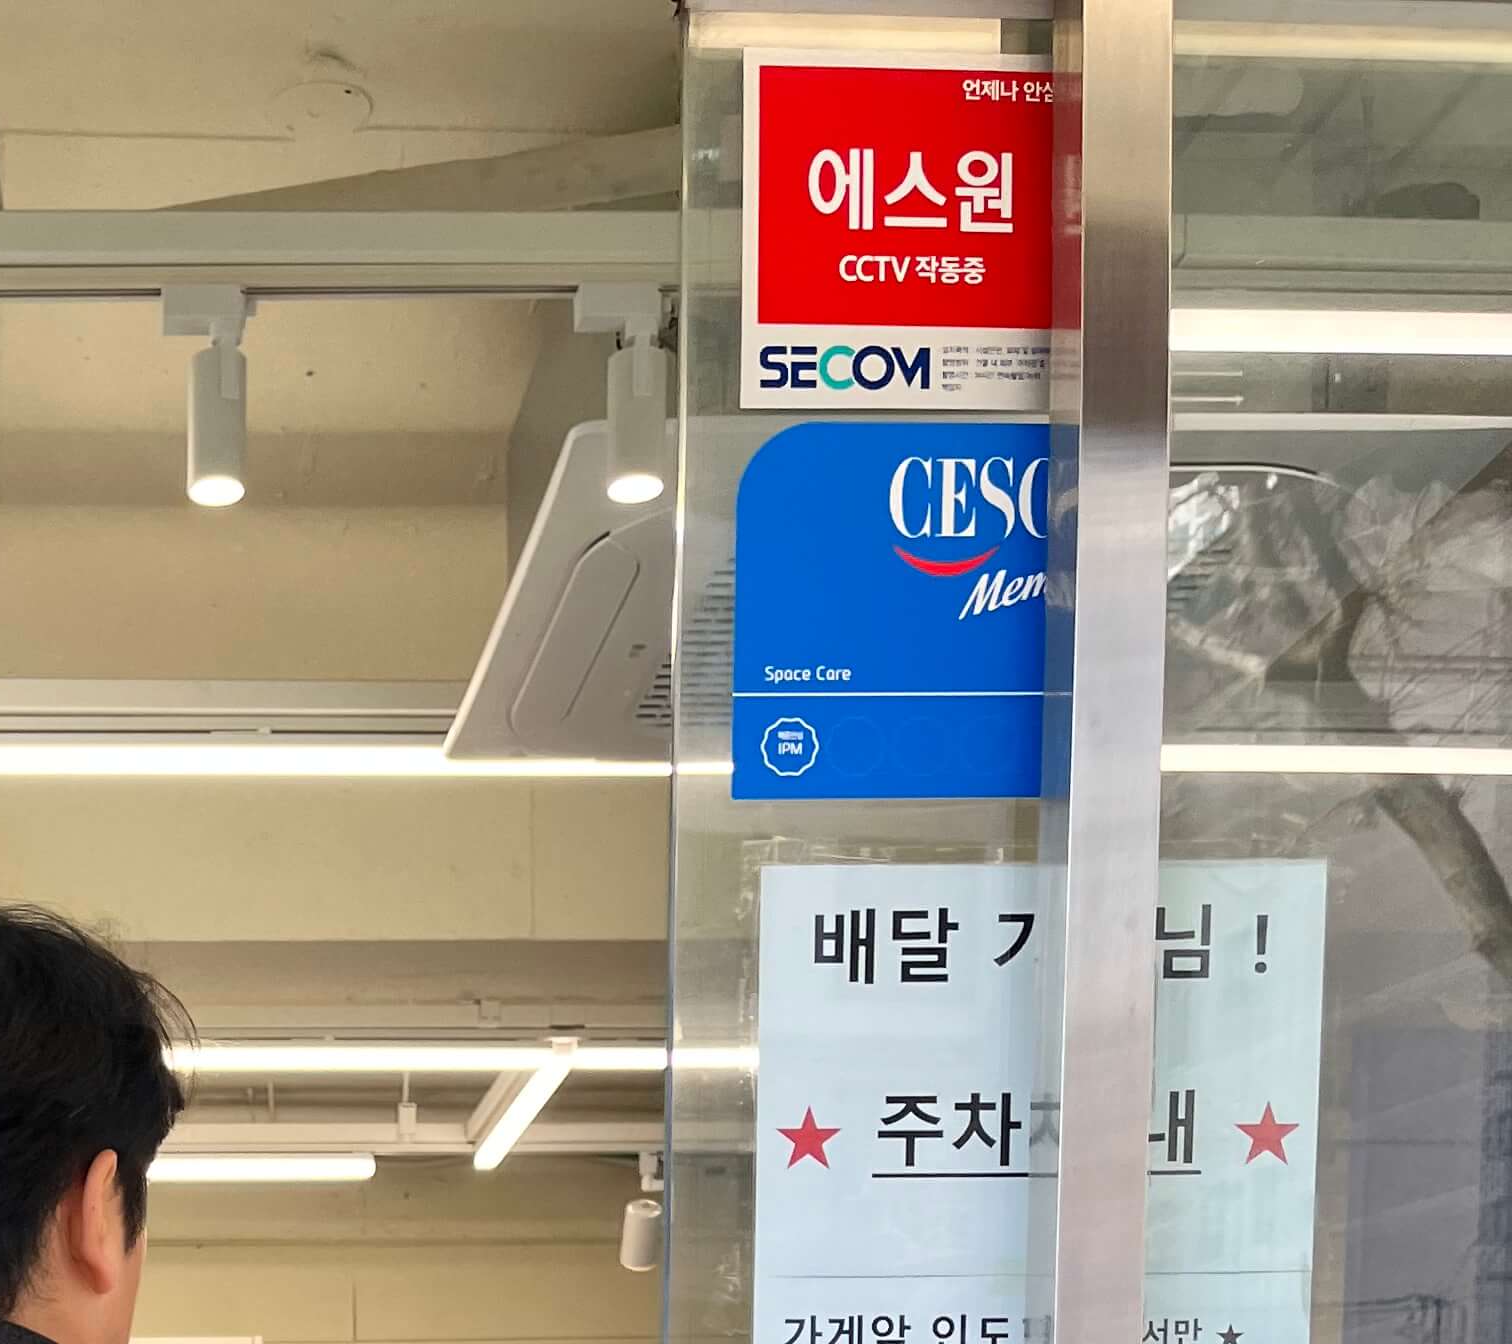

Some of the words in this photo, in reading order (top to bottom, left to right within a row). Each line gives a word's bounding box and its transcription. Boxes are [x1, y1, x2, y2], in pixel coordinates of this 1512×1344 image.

[963, 79, 1019, 102] 언제나
[808, 148, 1014, 233] 에스원
[839, 255, 911, 282] CCTV
[915, 256, 986, 285] 작동중
[760, 345, 930, 390] SECOM
[764, 665, 811, 684] Space
[816, 665, 852, 681] Care
[777, 742, 803, 755] IPM
[814, 908, 959, 984] 배달
